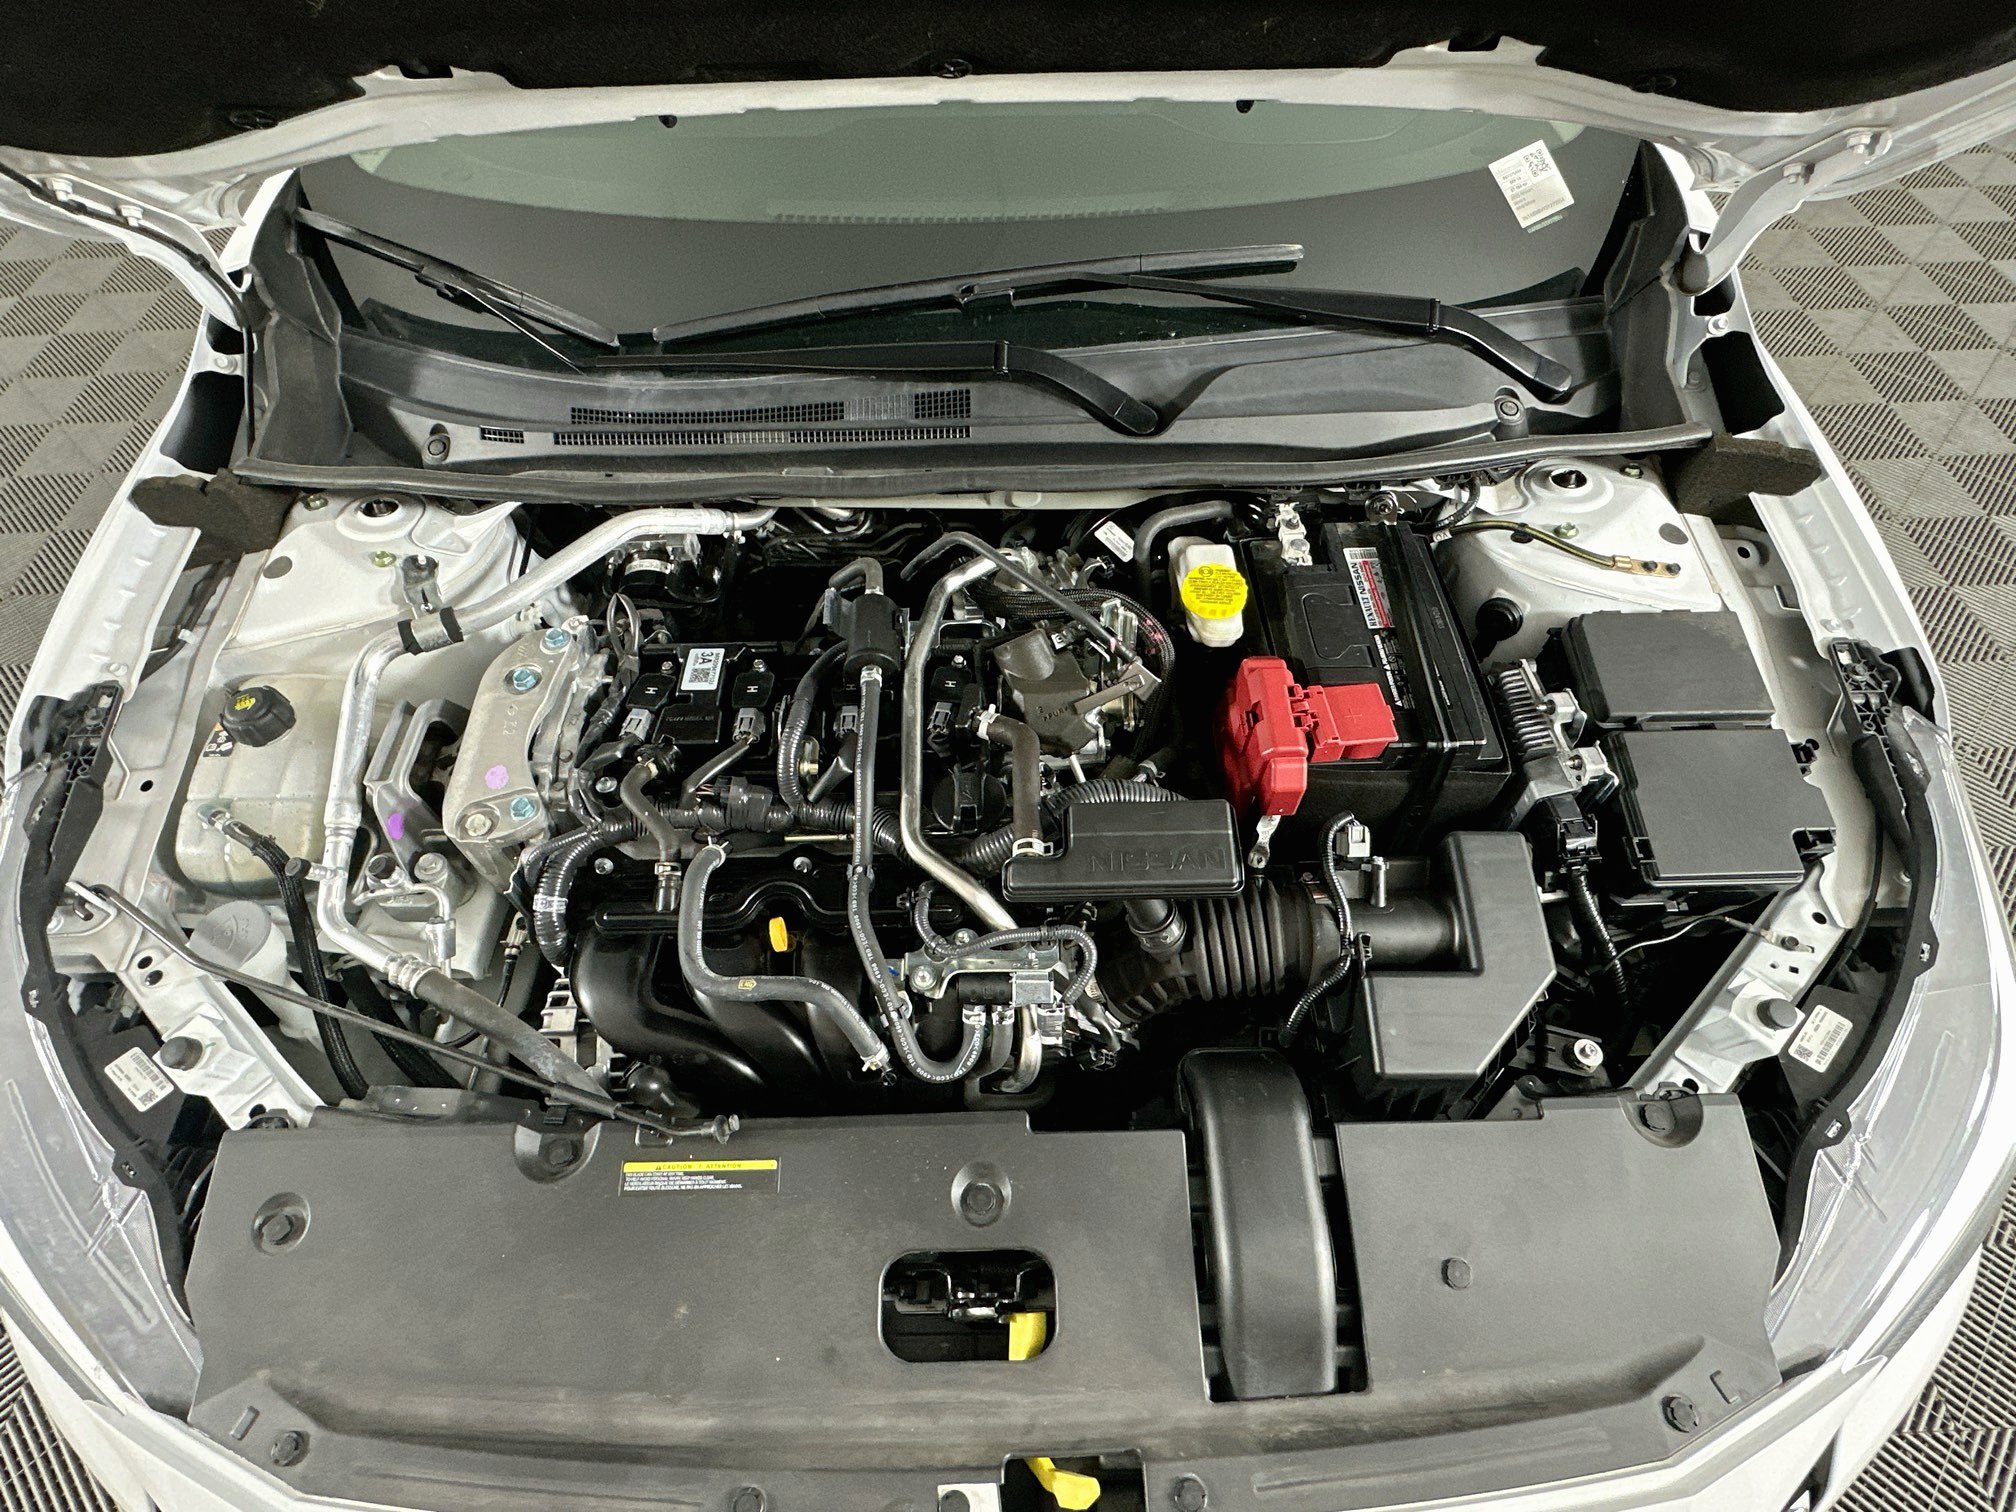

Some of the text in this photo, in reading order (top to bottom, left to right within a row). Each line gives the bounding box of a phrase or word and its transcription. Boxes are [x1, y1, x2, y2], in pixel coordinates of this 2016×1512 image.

[1351, 562, 1366, 595] NISSAN
[1363, 596, 1377, 627] RENAULT
[698, 651, 714, 665] 3A
[644, 686, 659, 695] H
[746, 685, 758, 693] H
[1088, 850, 1228, 873] NISSAN
